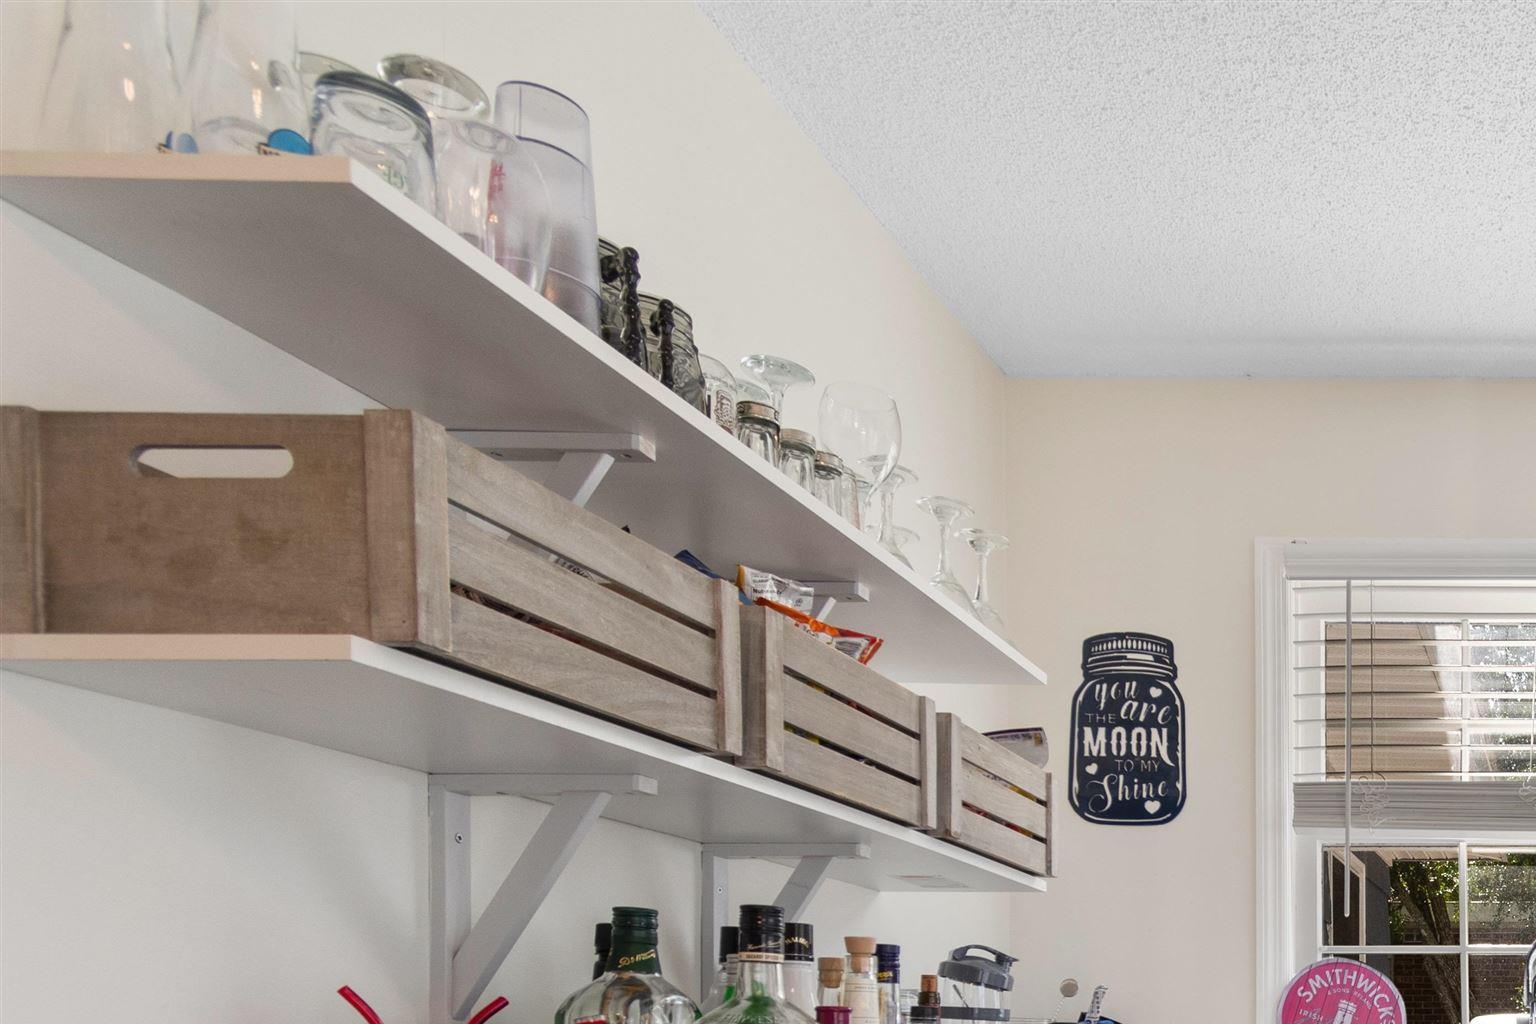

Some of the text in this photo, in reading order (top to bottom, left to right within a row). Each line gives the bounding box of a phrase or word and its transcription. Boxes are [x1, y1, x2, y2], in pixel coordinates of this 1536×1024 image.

[1085, 712, 1117, 725] THE
[1120, 700, 1172, 725] are
[1083, 726, 1175, 767] MOON
[1114, 759, 1160, 773] TO MY
[1086, 773, 1168, 813] Shine
[1299, 1008, 1324, 1022] IRISH
